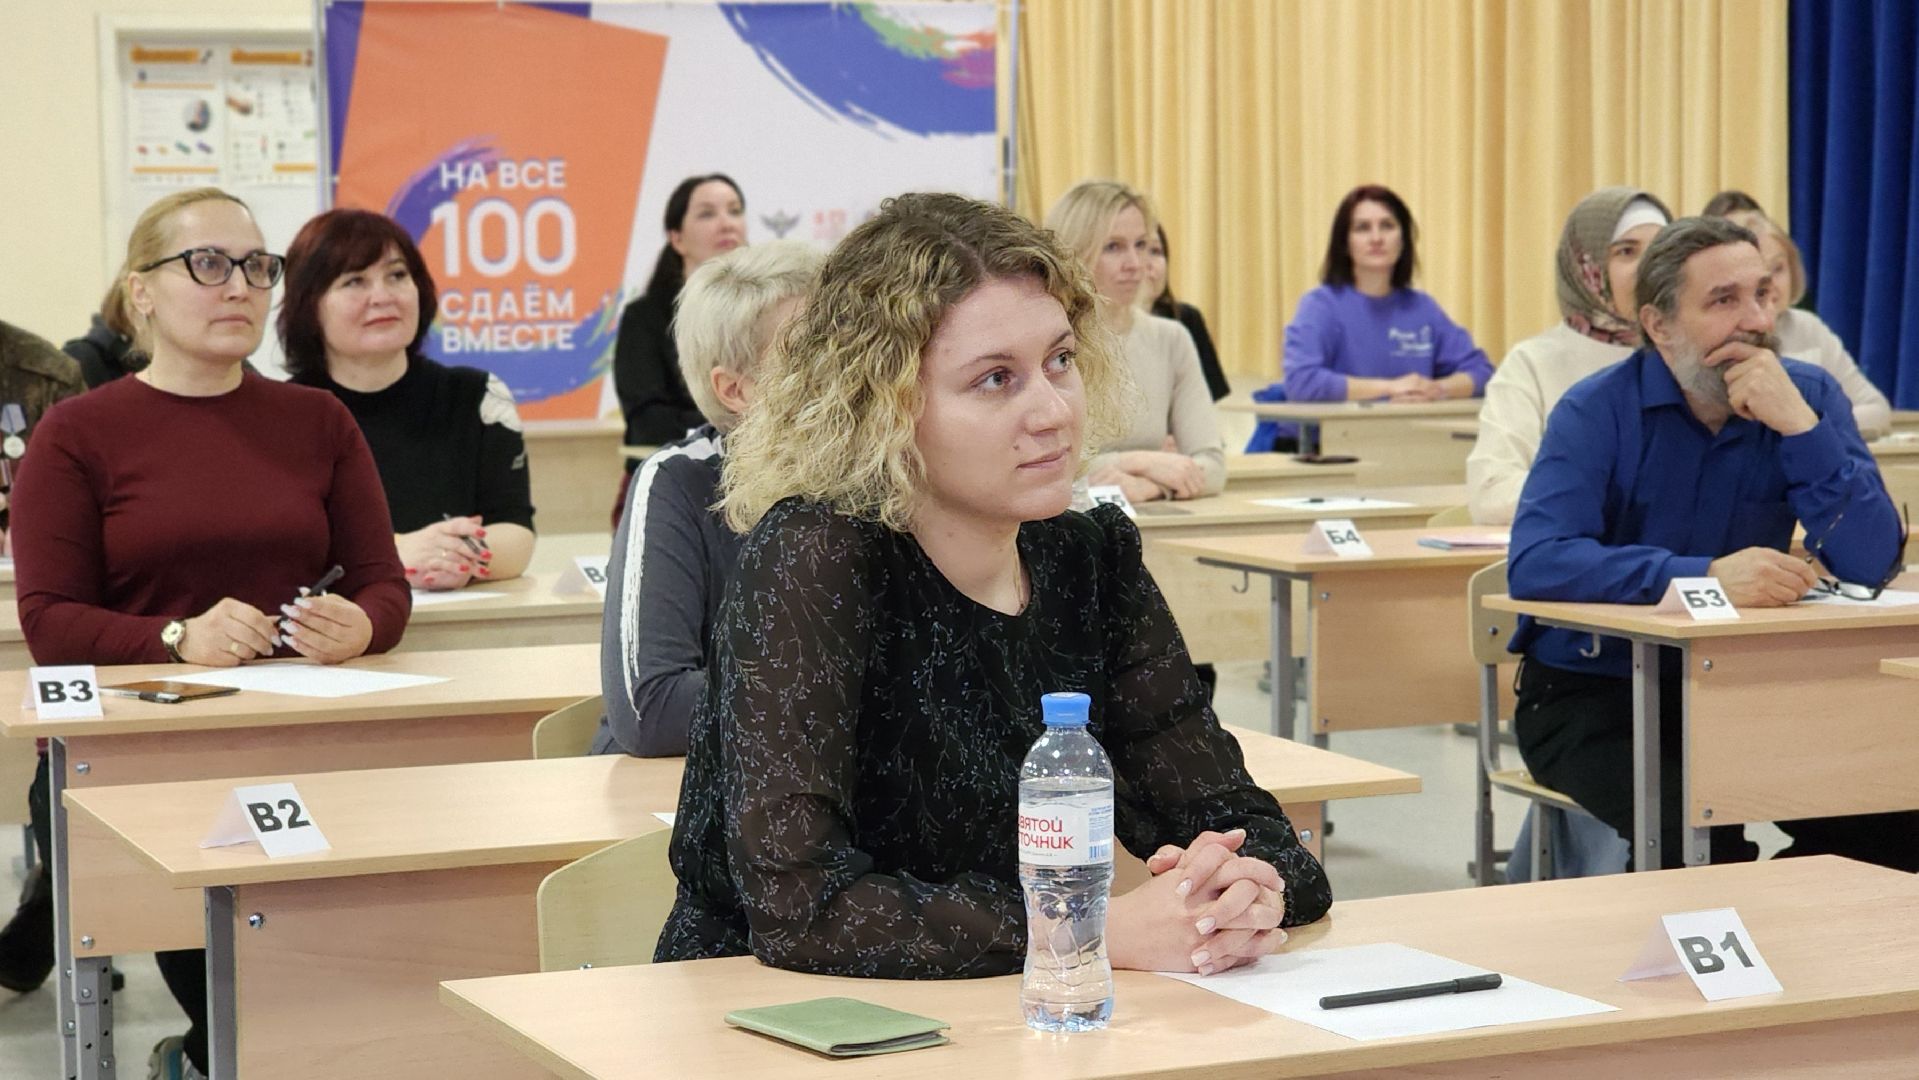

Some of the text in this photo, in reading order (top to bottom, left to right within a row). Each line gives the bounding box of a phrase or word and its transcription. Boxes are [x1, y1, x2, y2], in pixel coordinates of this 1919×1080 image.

[440, 160, 567, 189] НА ВСЕ
[431, 199, 577, 278] 100
[440, 284, 574, 322] СДАЁМ
[441, 323, 577, 353] ВМЕСТЕ
[1324, 529, 1361, 546] Б4
[1681, 588, 1727, 609] Б3
[38, 679, 94, 703] В3
[246, 798, 311, 833] В2
[1018, 815, 1063, 833] ВЯТОЙ
[1018, 831, 1074, 849] ТОЧНИК
[1678, 930, 1755, 975] В1
